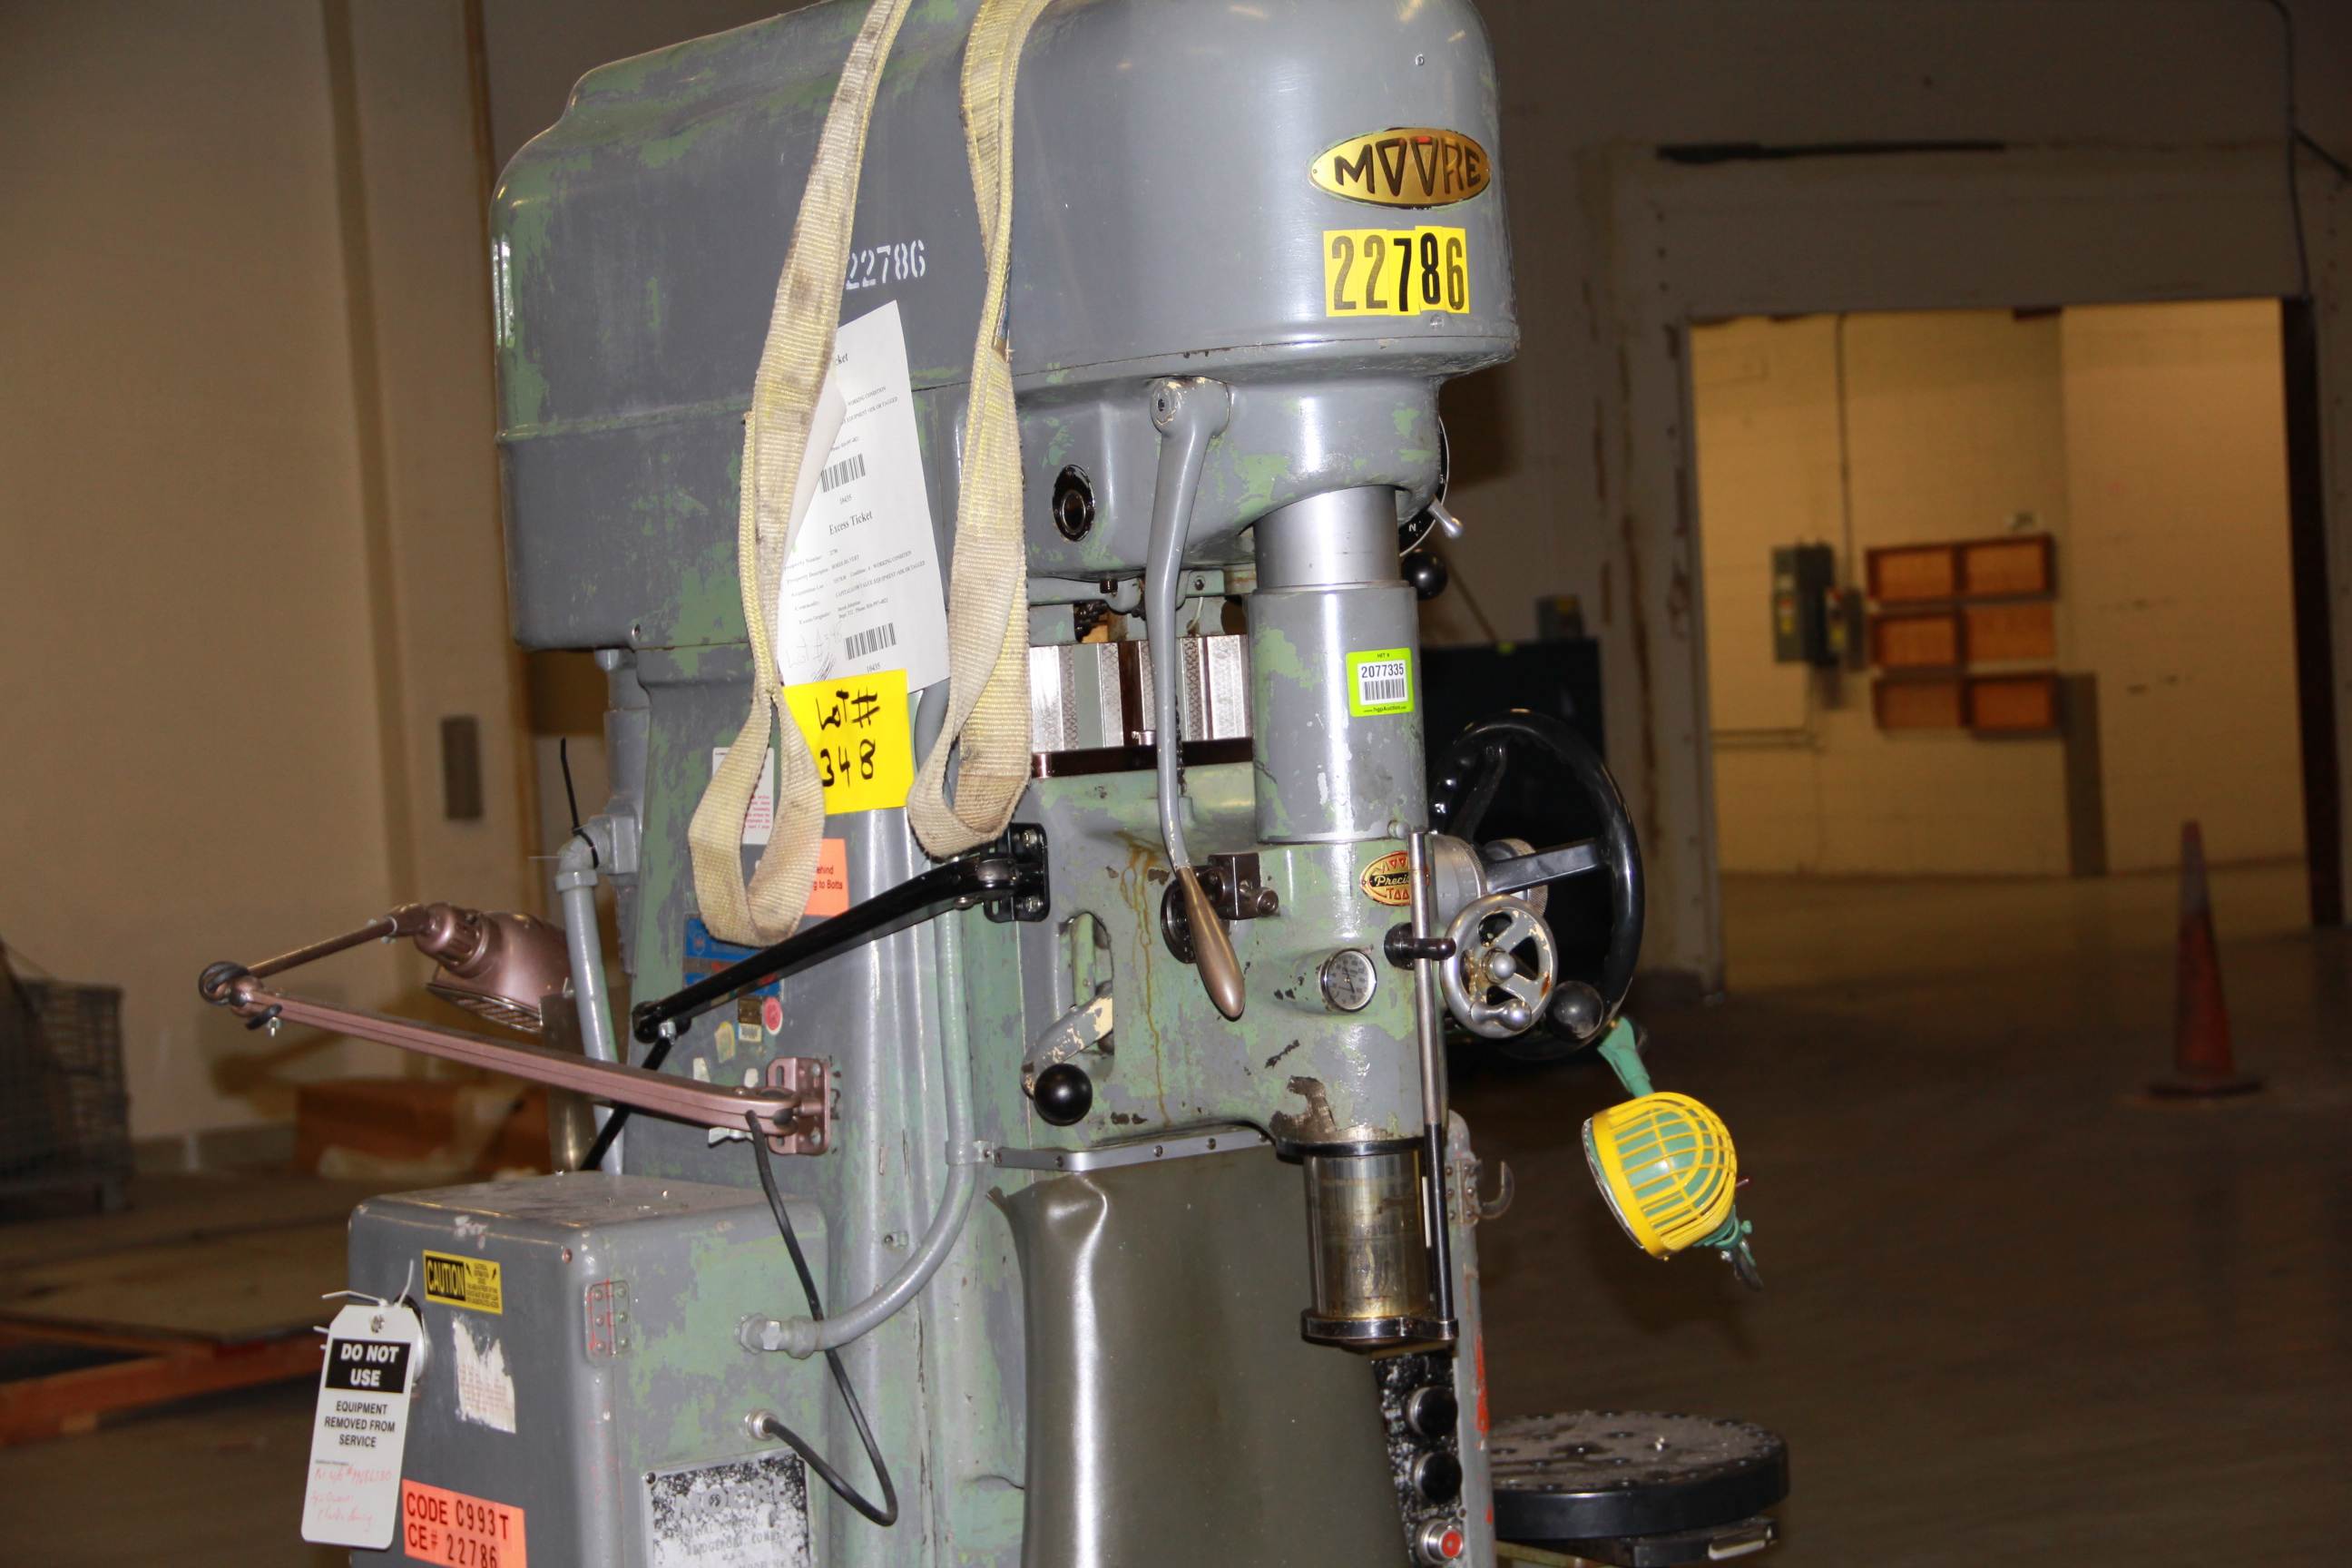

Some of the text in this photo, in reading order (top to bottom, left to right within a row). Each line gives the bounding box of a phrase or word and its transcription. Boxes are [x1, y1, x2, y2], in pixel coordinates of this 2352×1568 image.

[1333, 136, 1481, 197] MOORE
[845, 239, 926, 290] 22786
[1330, 231, 1465, 312] 22786
[828, 510, 873, 535] Excess Ticket
[1361, 663, 1405, 679] 2077335
[819, 739, 877, 789] 348
[817, 865, 834, 875] ehind
[427, 1259, 466, 1297] CAUTION
[340, 1343, 399, 1363] DO NOT
[349, 1367, 381, 1387] USE
[336, 1400, 387, 1415] EQUIPMENT
[324, 1416, 396, 1432] REMOVED FROM
[338, 1434, 377, 1448] SERVICE
[406, 1492, 448, 1525] CODE
[446, 1534, 498, 1568] 22786
